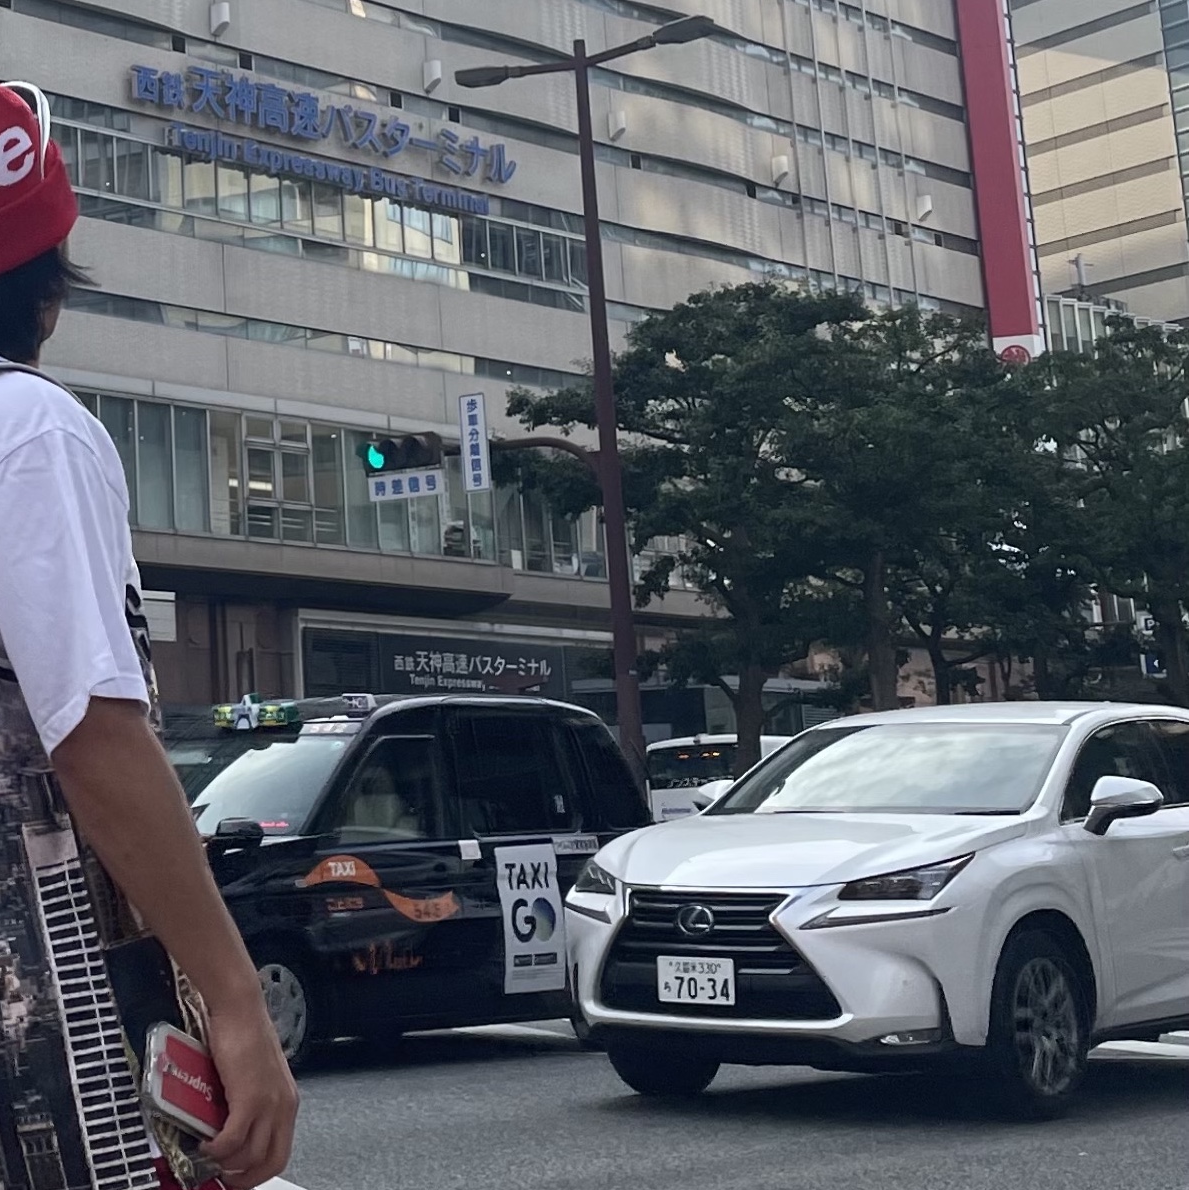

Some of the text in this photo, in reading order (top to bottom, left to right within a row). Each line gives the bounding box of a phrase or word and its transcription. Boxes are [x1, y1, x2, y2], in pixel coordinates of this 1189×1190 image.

[168, 121, 491, 215] Tenjin Expressway Bus Terminal
[327, 860, 356, 877] TAXI
[504, 861, 550, 890] TAXI
[512, 897, 556, 943] GO
[674, 975, 730, 1002] 70-34
